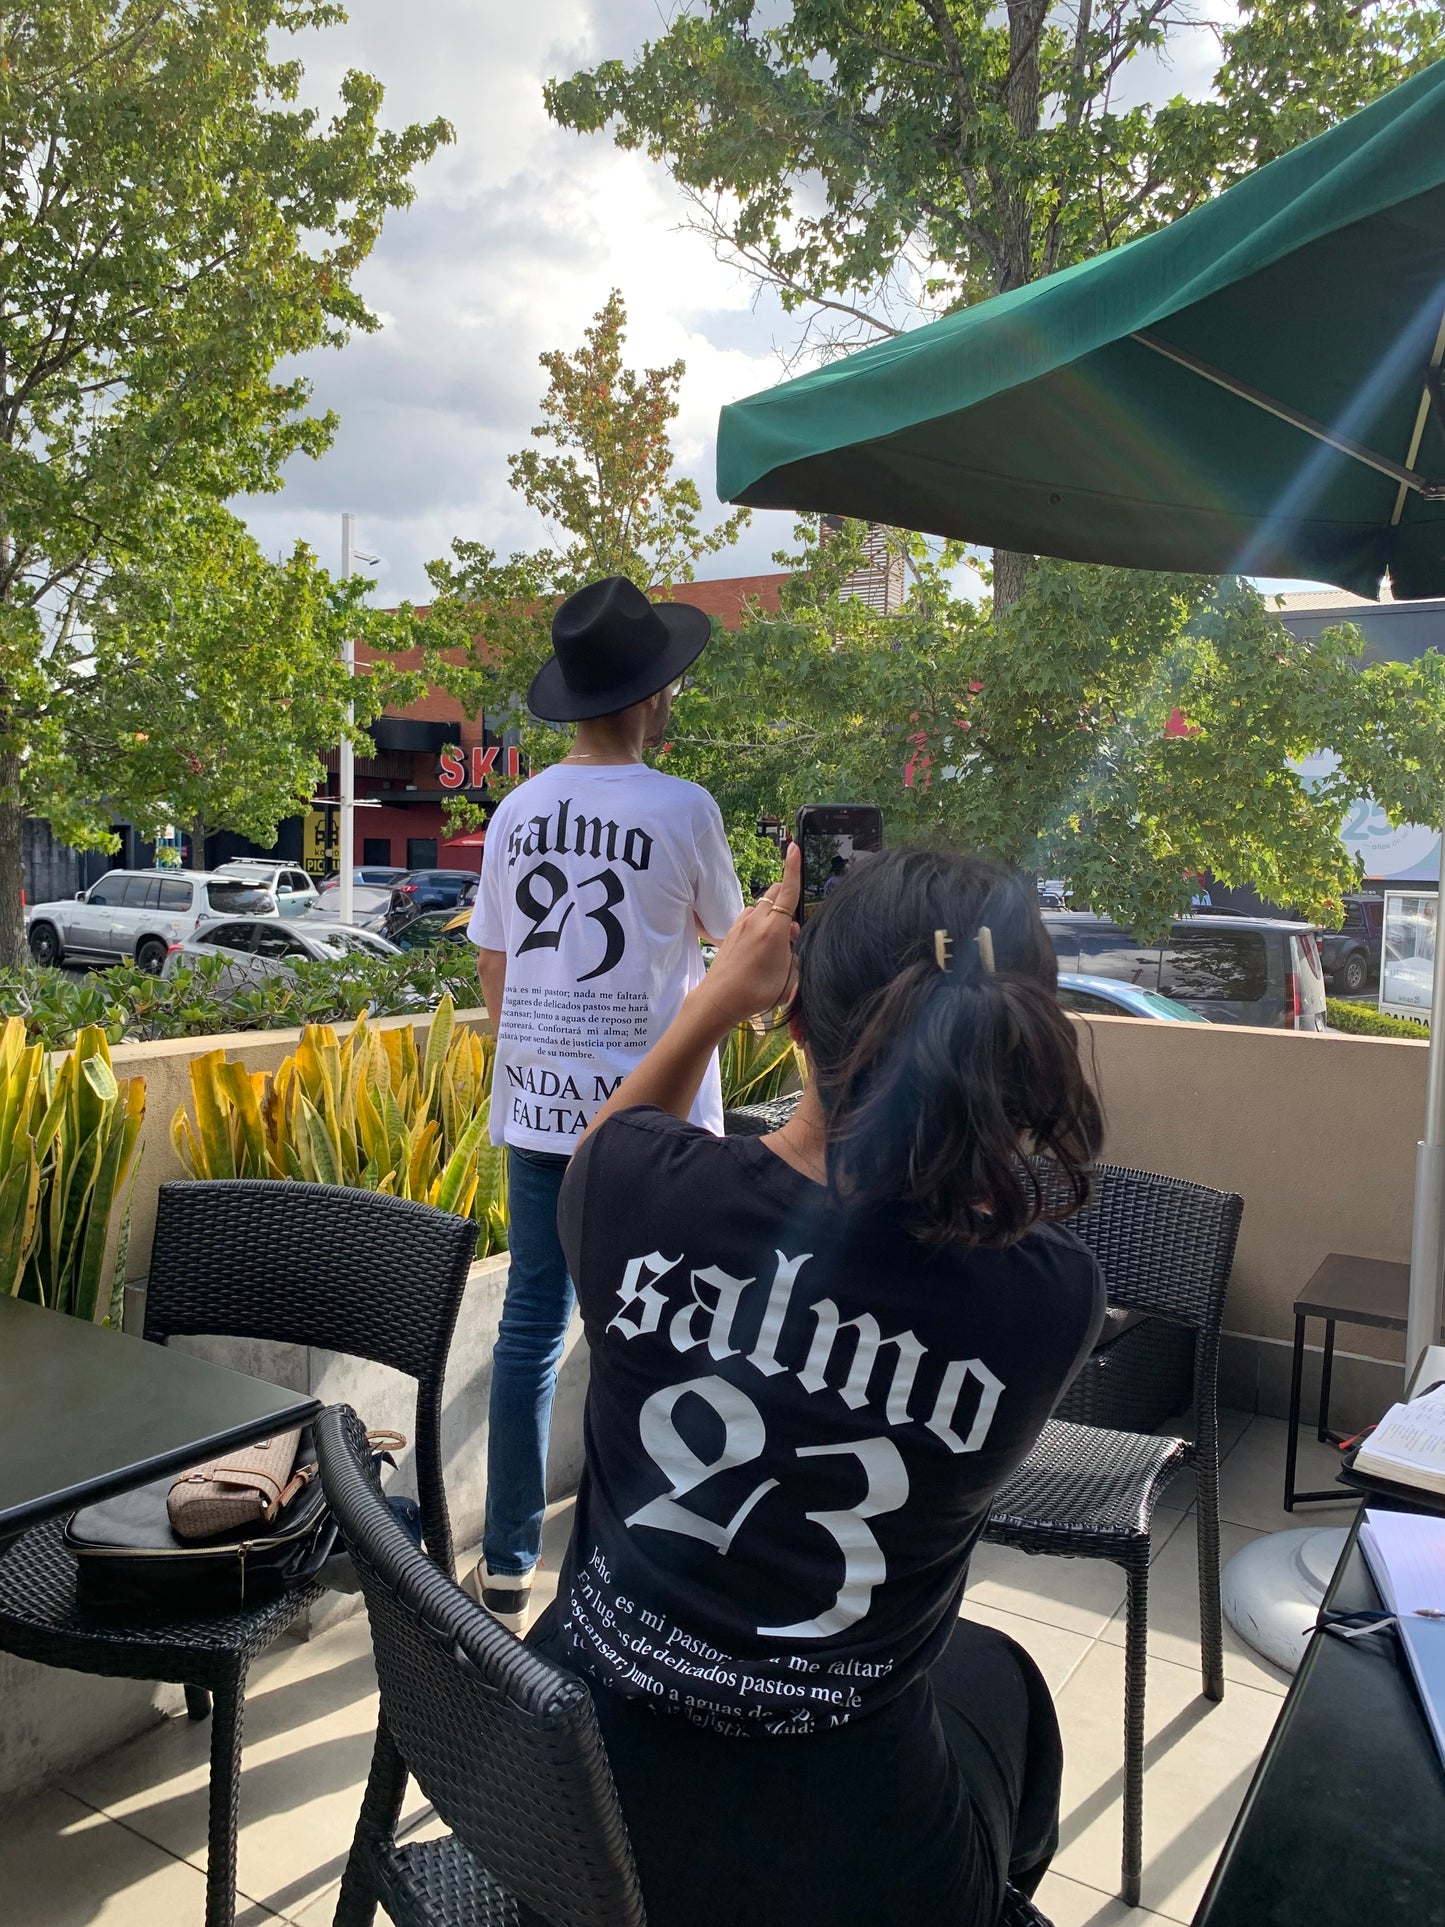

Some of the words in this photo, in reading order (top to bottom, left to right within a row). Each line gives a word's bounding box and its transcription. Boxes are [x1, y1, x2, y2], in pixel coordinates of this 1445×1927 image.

[515, 861, 625, 982] 23
[505, 985, 517, 993] ová
[532, 987, 542, 995] mi
[545, 989, 570, 998] pastor;
[573, 989, 596, 998] nada
[600, 992, 613, 1000] me
[617, 991, 649, 1000] faltará.
[505, 996, 532, 1007] lugares
[533, 998, 543, 1007] de
[544, 999, 581, 1010] delicados
[583, 1003, 611, 1013] pastos
[628, 1003, 649, 1012] hará
[561, 1015, 585, 1024] aguas
[588, 1014, 599, 1023] de
[601, 1017, 632, 1026] reposo
[538, 1023, 582, 1035] Confortará
[587, 1027, 599, 1035] mi
[603, 1027, 629, 1037] alma;
[634, 1027, 648, 1036] Me
[533, 1036, 558, 1045] sendas
[560, 1037, 571, 1046] de
[572, 1038, 604, 1048] justicia
[606, 1040, 622, 1050] por
[623, 1040, 648, 1048] amor
[537, 1047, 546, 1055] de
[559, 1050, 595, 1059] nombre.
[505, 1064, 584, 1101] NADA
[593, 1076, 624, 1101] M
[513, 1096, 598, 1135] FALTA
[624, 1374, 910, 1638] 23
[589, 1545, 612, 1584] Jeho
[615, 1595, 635, 1615] es
[639, 1609, 667, 1633] mi
[788, 1656, 820, 1674] me
[577, 1569, 594, 1600] En
[630, 1636, 652, 1656] de
[652, 1649, 737, 1687] delicados
[739, 1674, 806, 1696] pastos
[810, 1687, 843, 1705] me
[669, 1688, 679, 1701] a
